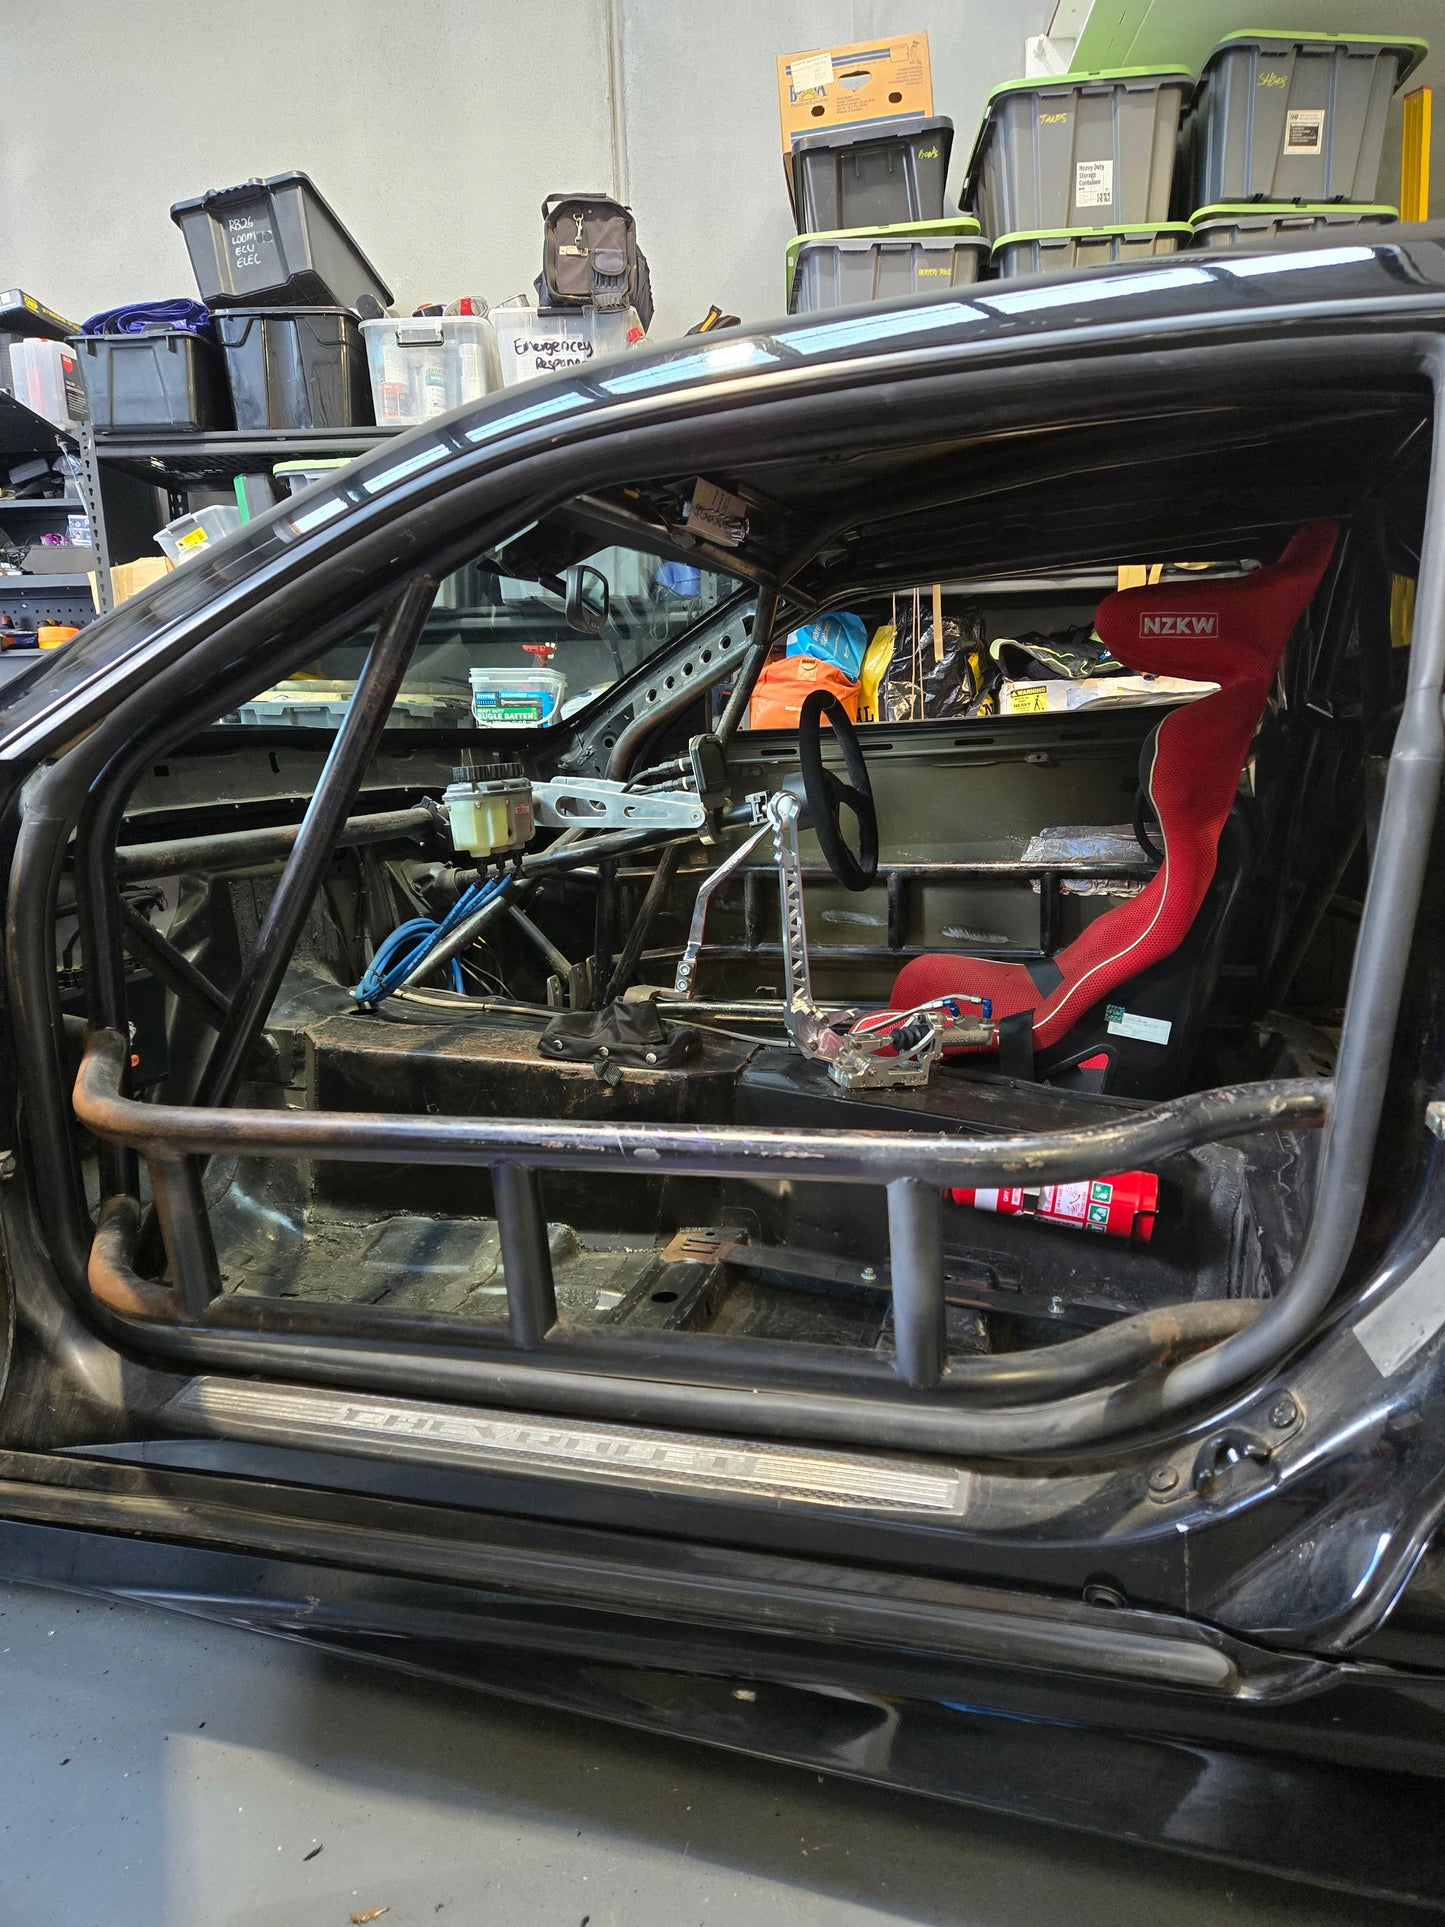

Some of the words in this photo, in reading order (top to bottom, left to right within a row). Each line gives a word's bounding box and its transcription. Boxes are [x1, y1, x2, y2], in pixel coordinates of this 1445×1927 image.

[1078, 164, 1093, 172] Heavy
[1094, 163, 1105, 171] Duty
[1078, 179, 1101, 187] Container
[229, 216, 254, 233] RB26
[235, 244, 255, 257] ECU
[236, 253, 262, 268] ELEC
[1143, 616, 1215, 634] NZKW
[477, 712, 503, 720] BUGLE
[503, 712, 535, 720] BATTEN
